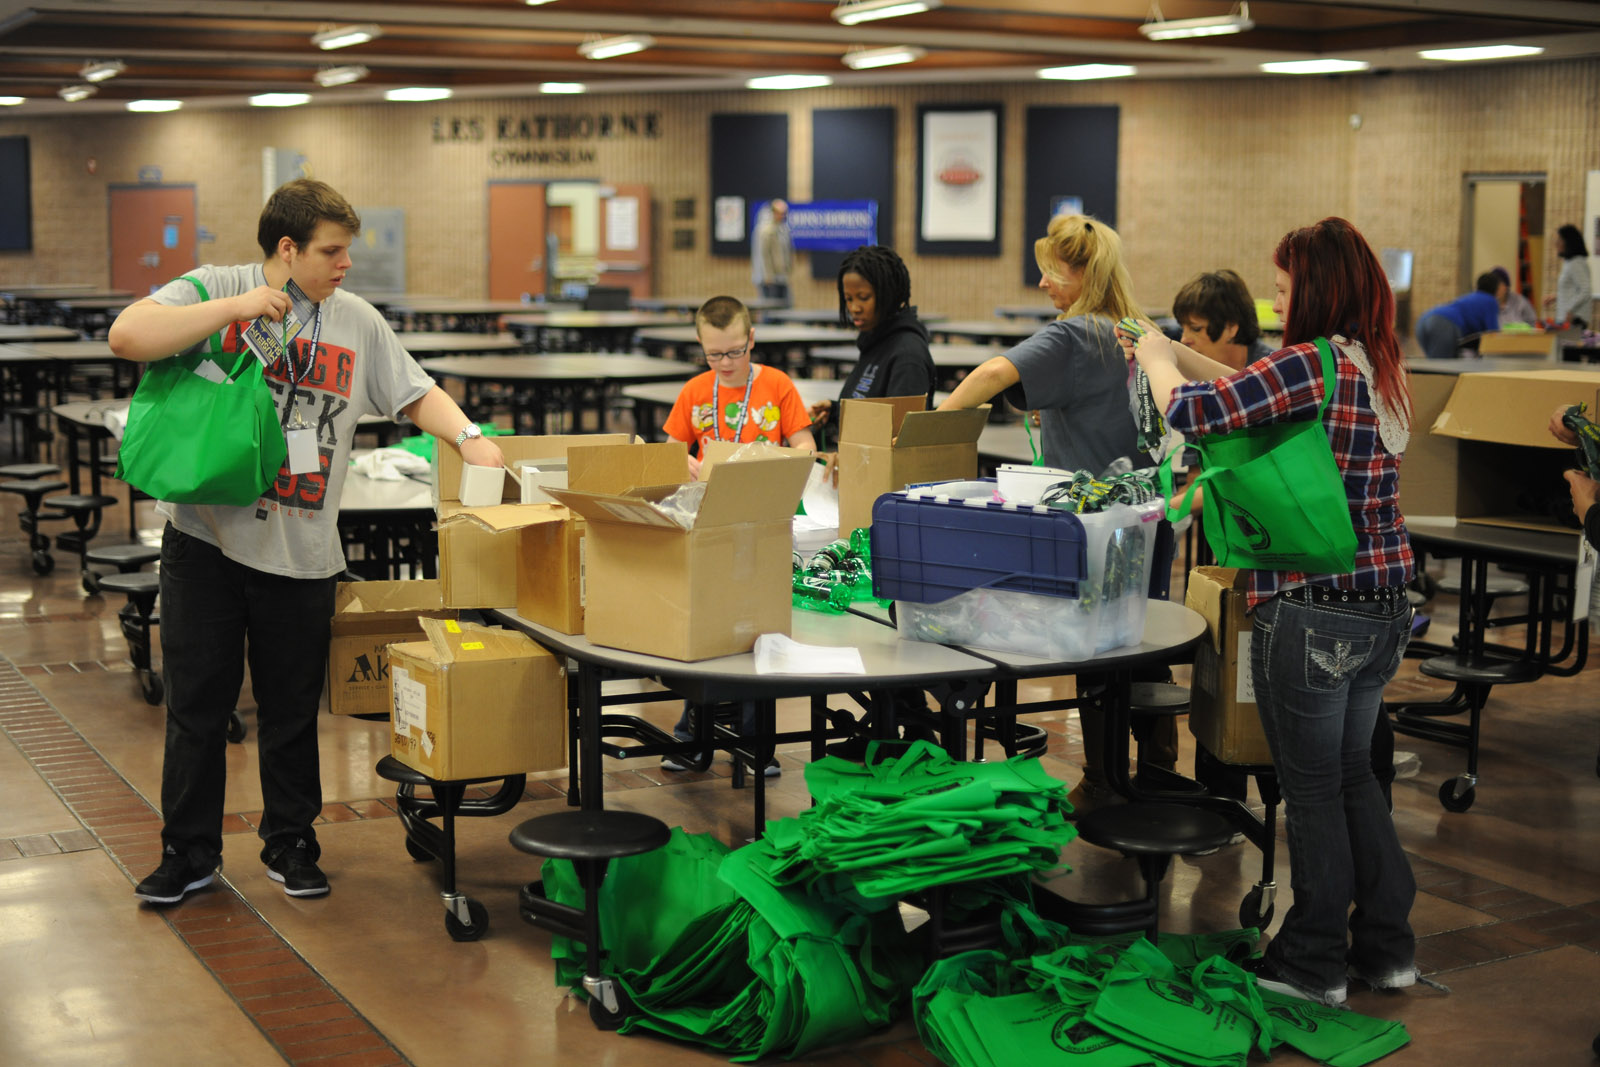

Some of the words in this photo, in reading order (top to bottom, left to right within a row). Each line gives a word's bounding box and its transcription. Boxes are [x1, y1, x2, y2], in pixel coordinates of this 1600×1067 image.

[432, 115, 485, 142] LES
[248, 324, 280, 363] MUSEUM
[312, 322, 321, 343] Science
[1144, 395, 1152, 433] Washington
